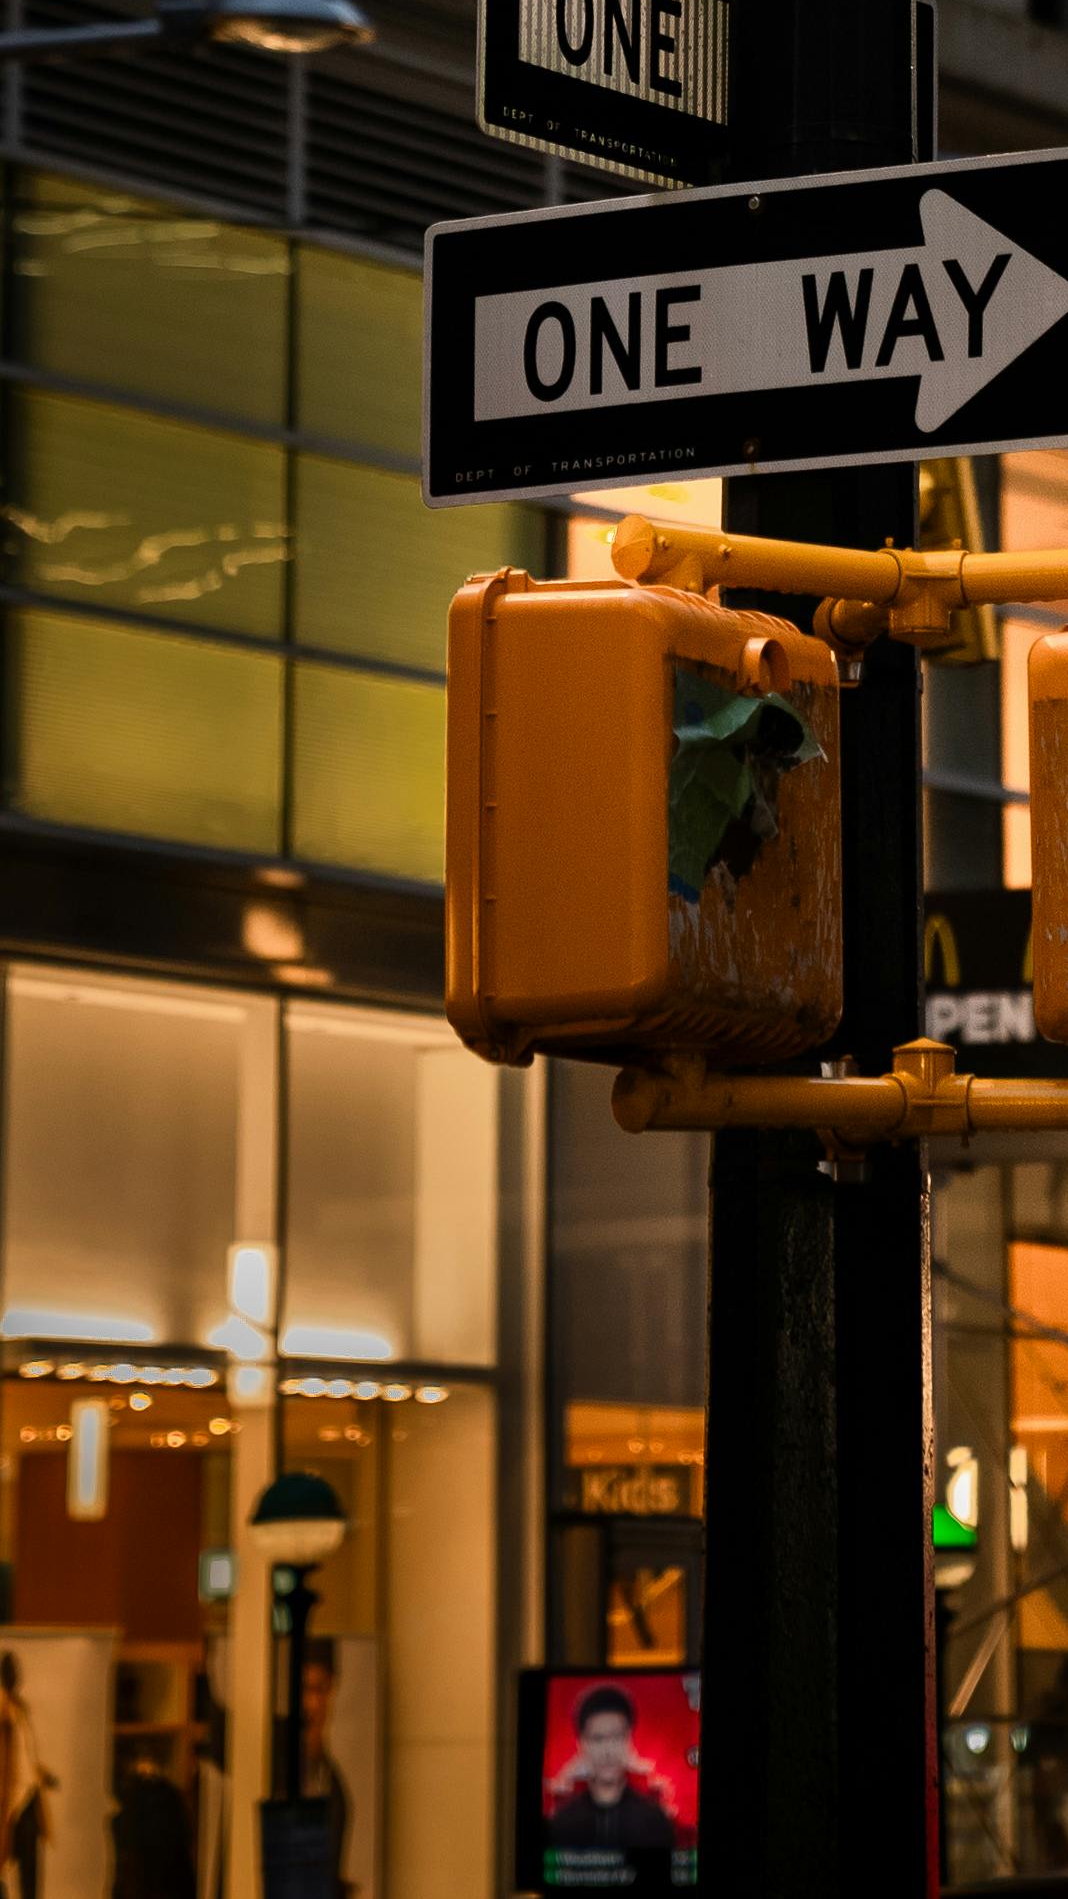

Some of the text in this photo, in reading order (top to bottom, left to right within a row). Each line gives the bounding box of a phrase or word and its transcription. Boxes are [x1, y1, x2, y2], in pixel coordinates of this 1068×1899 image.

[503, 105, 535, 125] DEPT
[546, 119, 561, 132] OF
[523, 253, 1012, 402] ONE WAY
[455, 447, 696, 483] DEPT OF TRANSPORTATION
